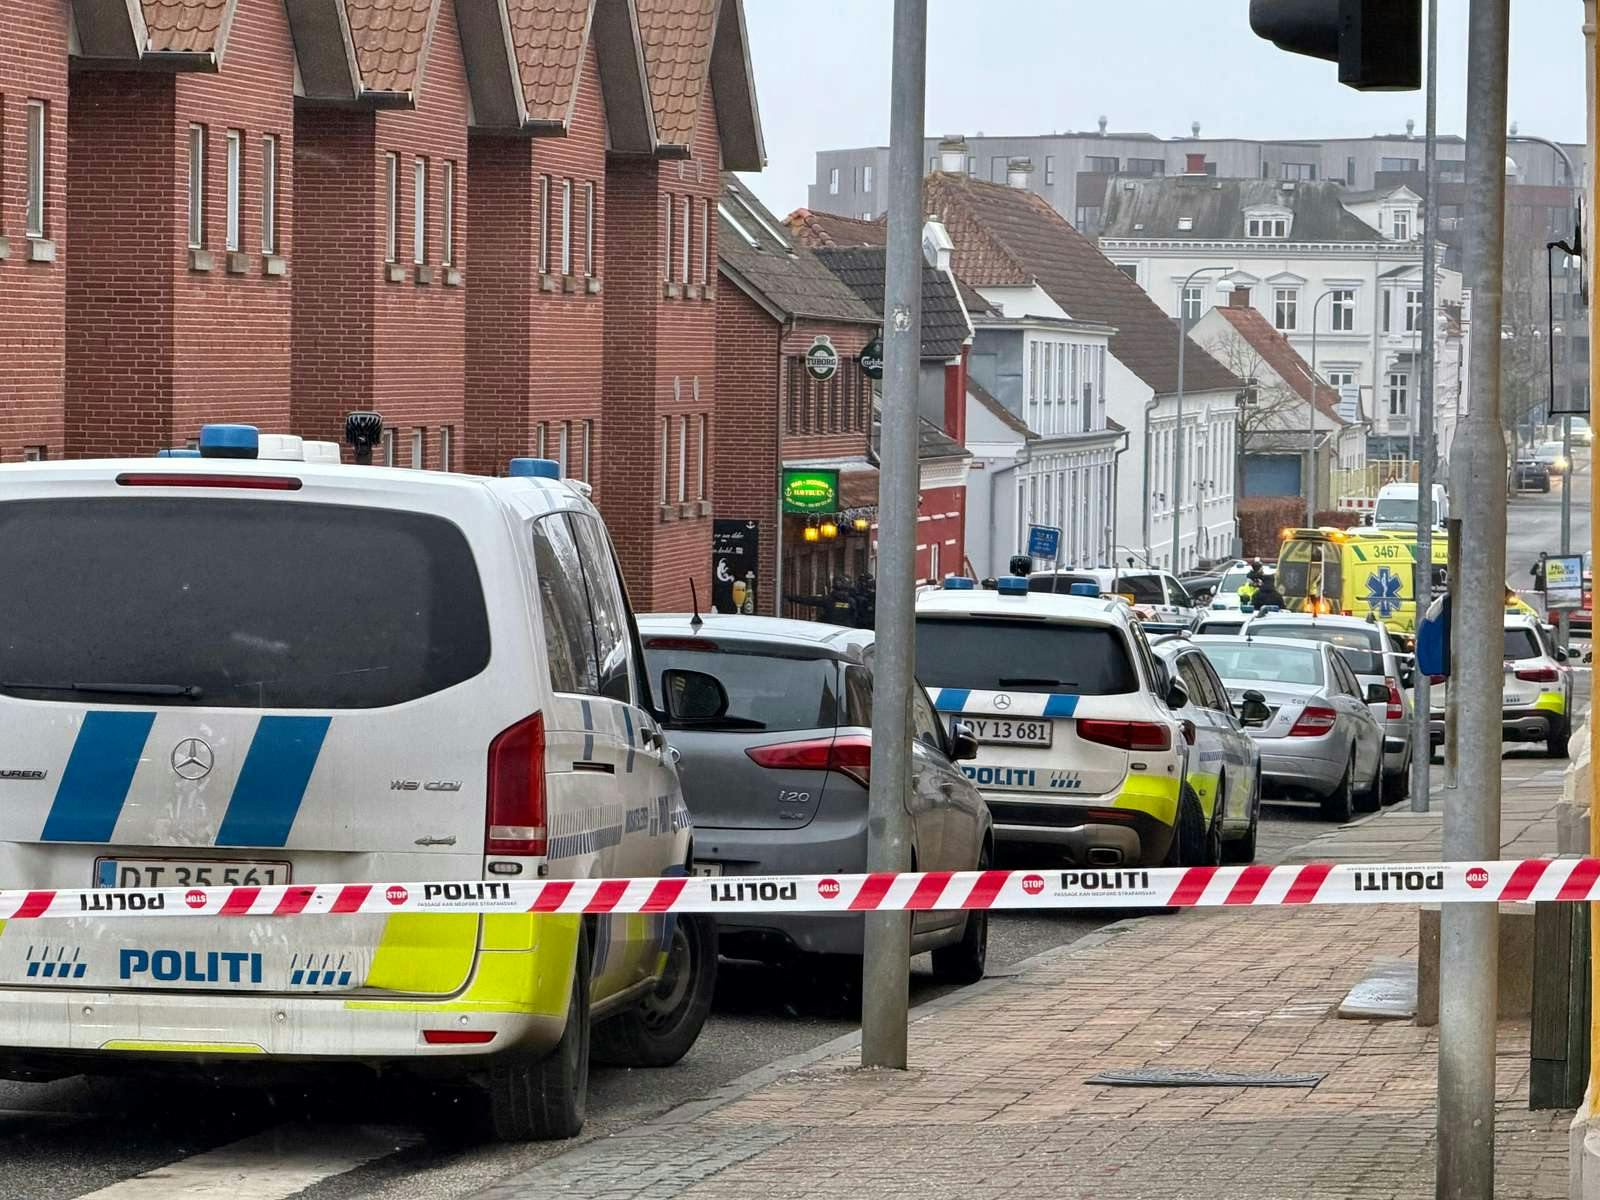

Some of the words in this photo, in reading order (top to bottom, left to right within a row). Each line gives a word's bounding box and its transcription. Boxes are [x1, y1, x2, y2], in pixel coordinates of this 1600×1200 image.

[808, 358, 836, 366] TUBORG
[1373, 545, 1399, 558] 3467
[993, 721, 1011, 738] 13
[1016, 722, 1046, 740] 681
[961, 767, 1034, 786] POLITI
[779, 790, 809, 801] i20
[121, 867, 165, 888] DT
[175, 868, 212, 887] 35
[223, 868, 275, 886] 561
[1022, 880, 1043, 888] STOP
[1061, 871, 1148, 889] POLITI
[1355, 871, 1443, 891] POLITI
[1467, 873, 1488, 881] STOP
[386, 891, 407, 899] STOP
[424, 882, 510, 900] POLITI
[711, 882, 797, 901] POLITI
[818, 884, 839, 892] STOP
[81, 893, 164, 911] POLITI
[120, 949, 262, 983] POLITI
